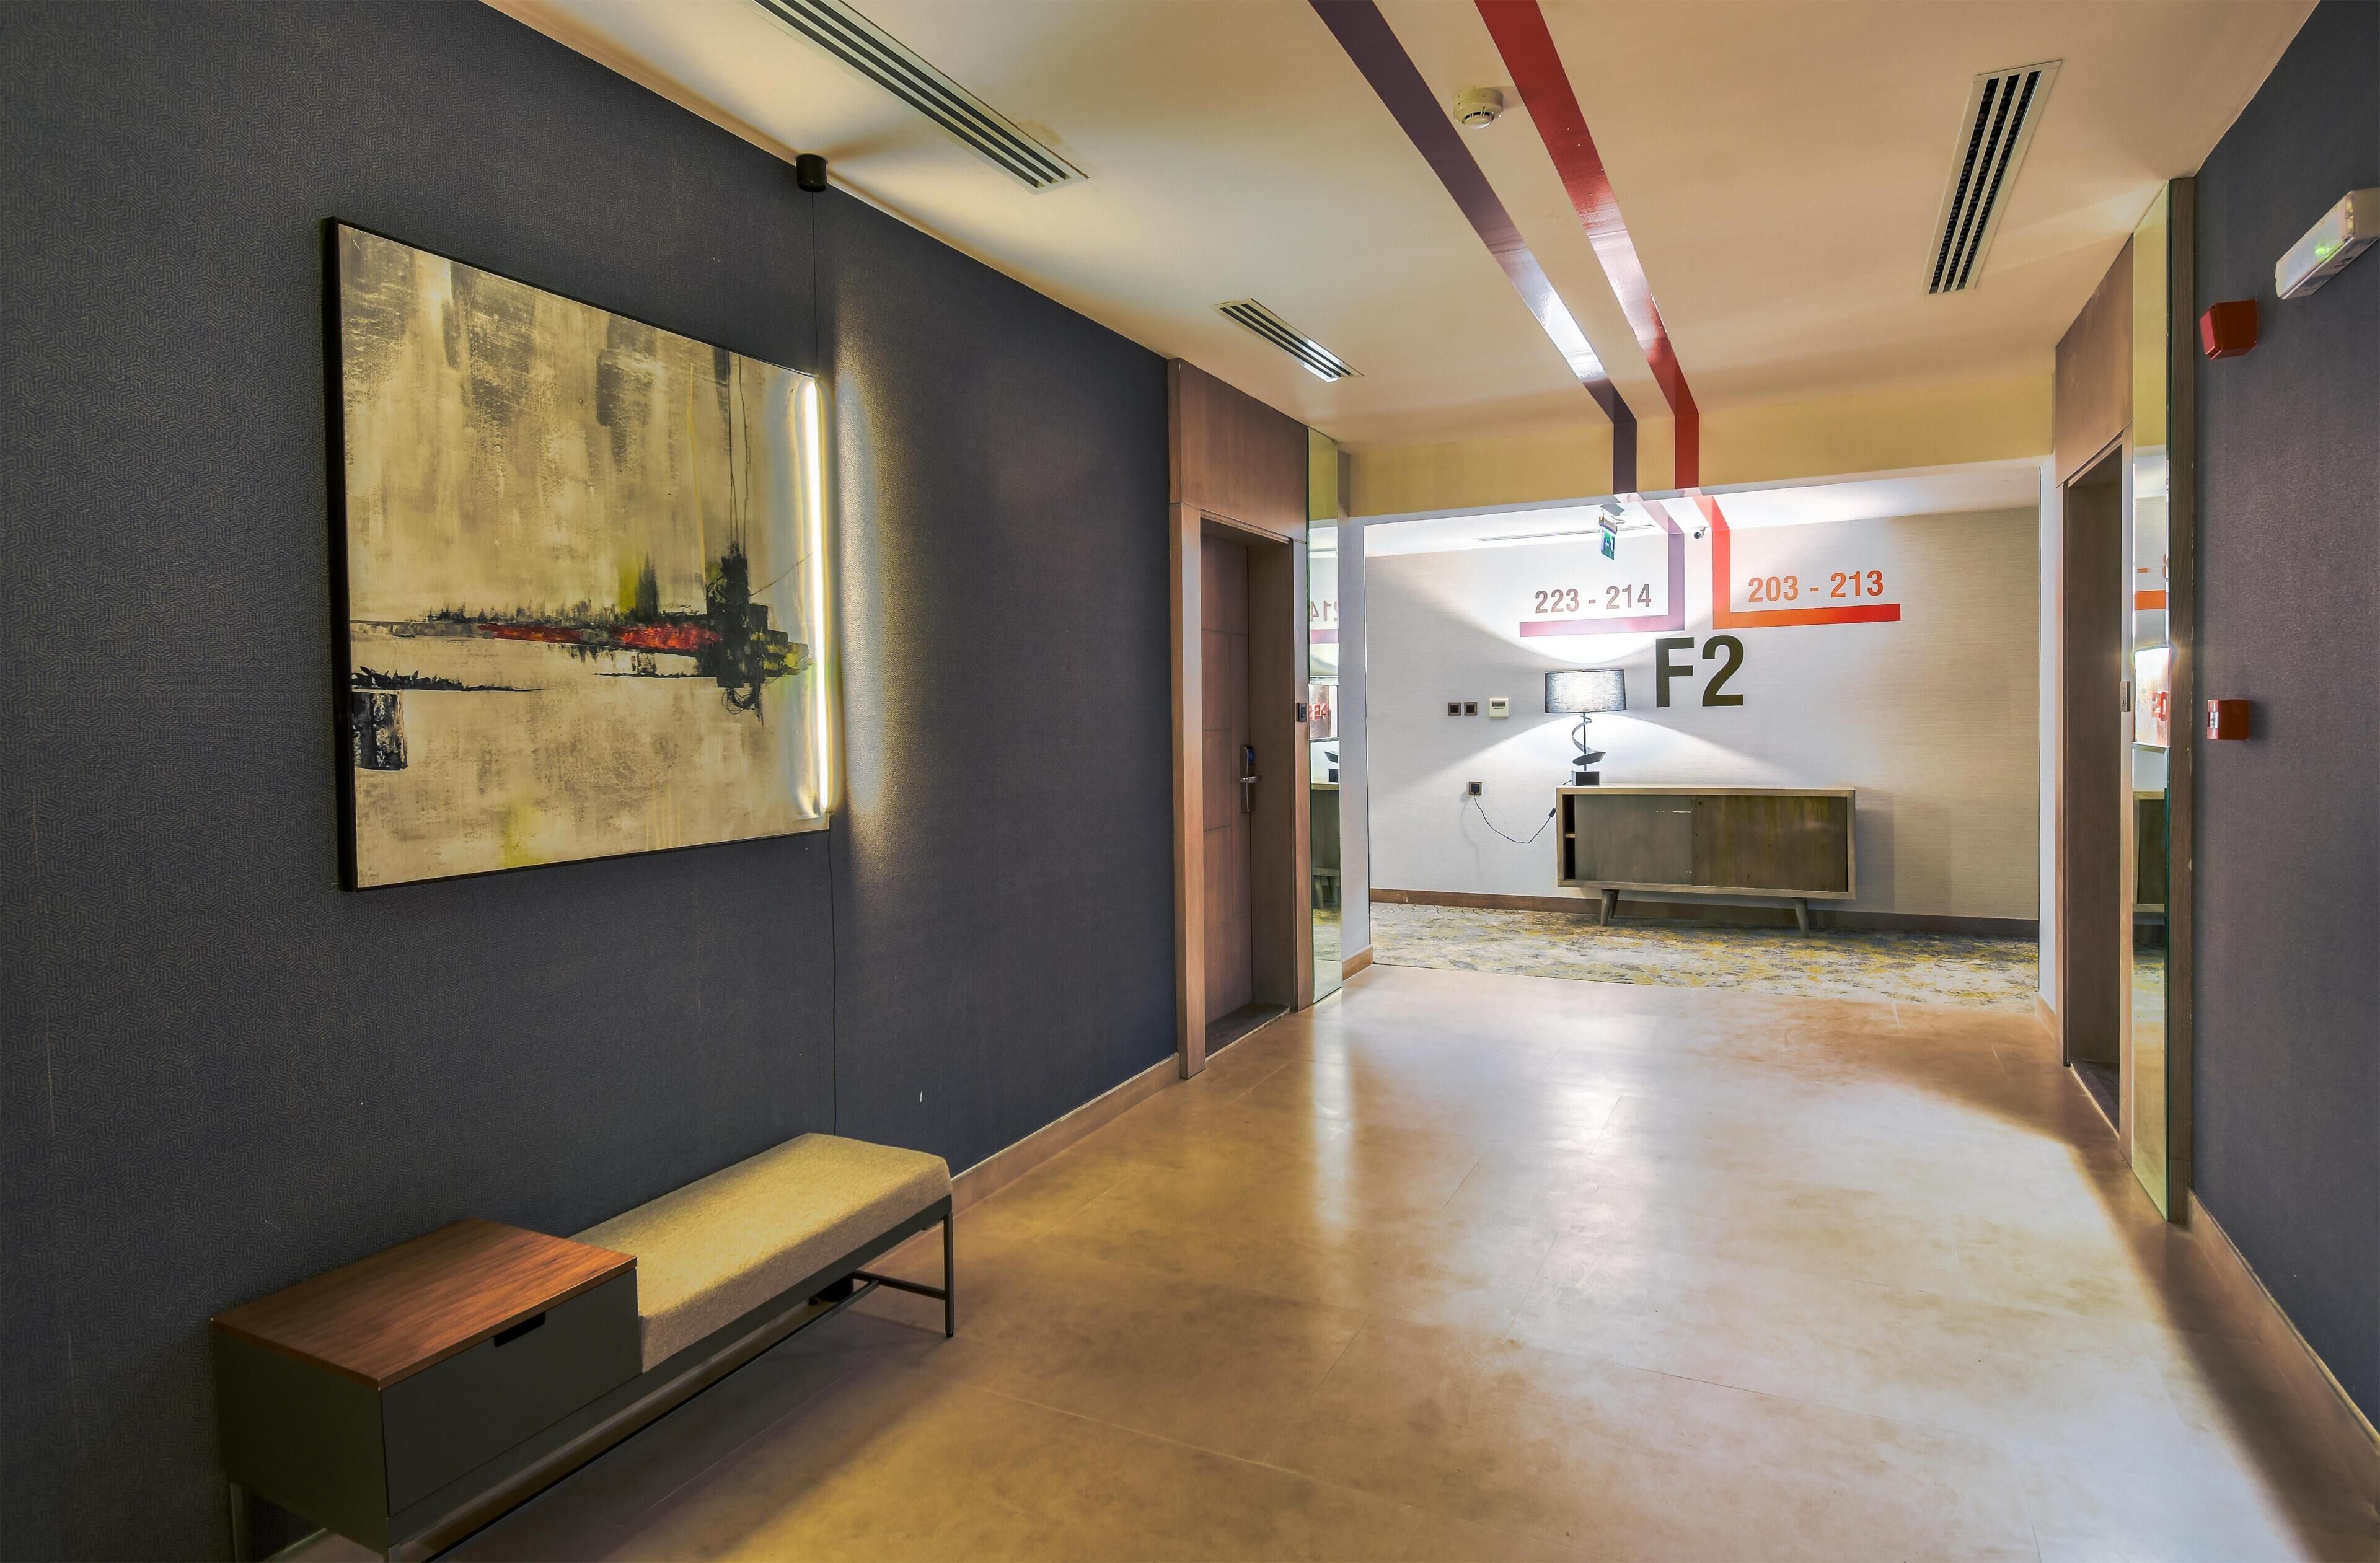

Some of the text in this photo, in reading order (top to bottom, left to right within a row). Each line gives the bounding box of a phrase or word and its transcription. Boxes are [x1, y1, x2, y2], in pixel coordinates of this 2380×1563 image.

[1535, 588, 1579, 614] 223
[1606, 584, 1652, 609] 214
[1748, 575, 1798, 602] 203
[1831, 570, 1884, 598] 213
[1655, 635, 1744, 708] F2
